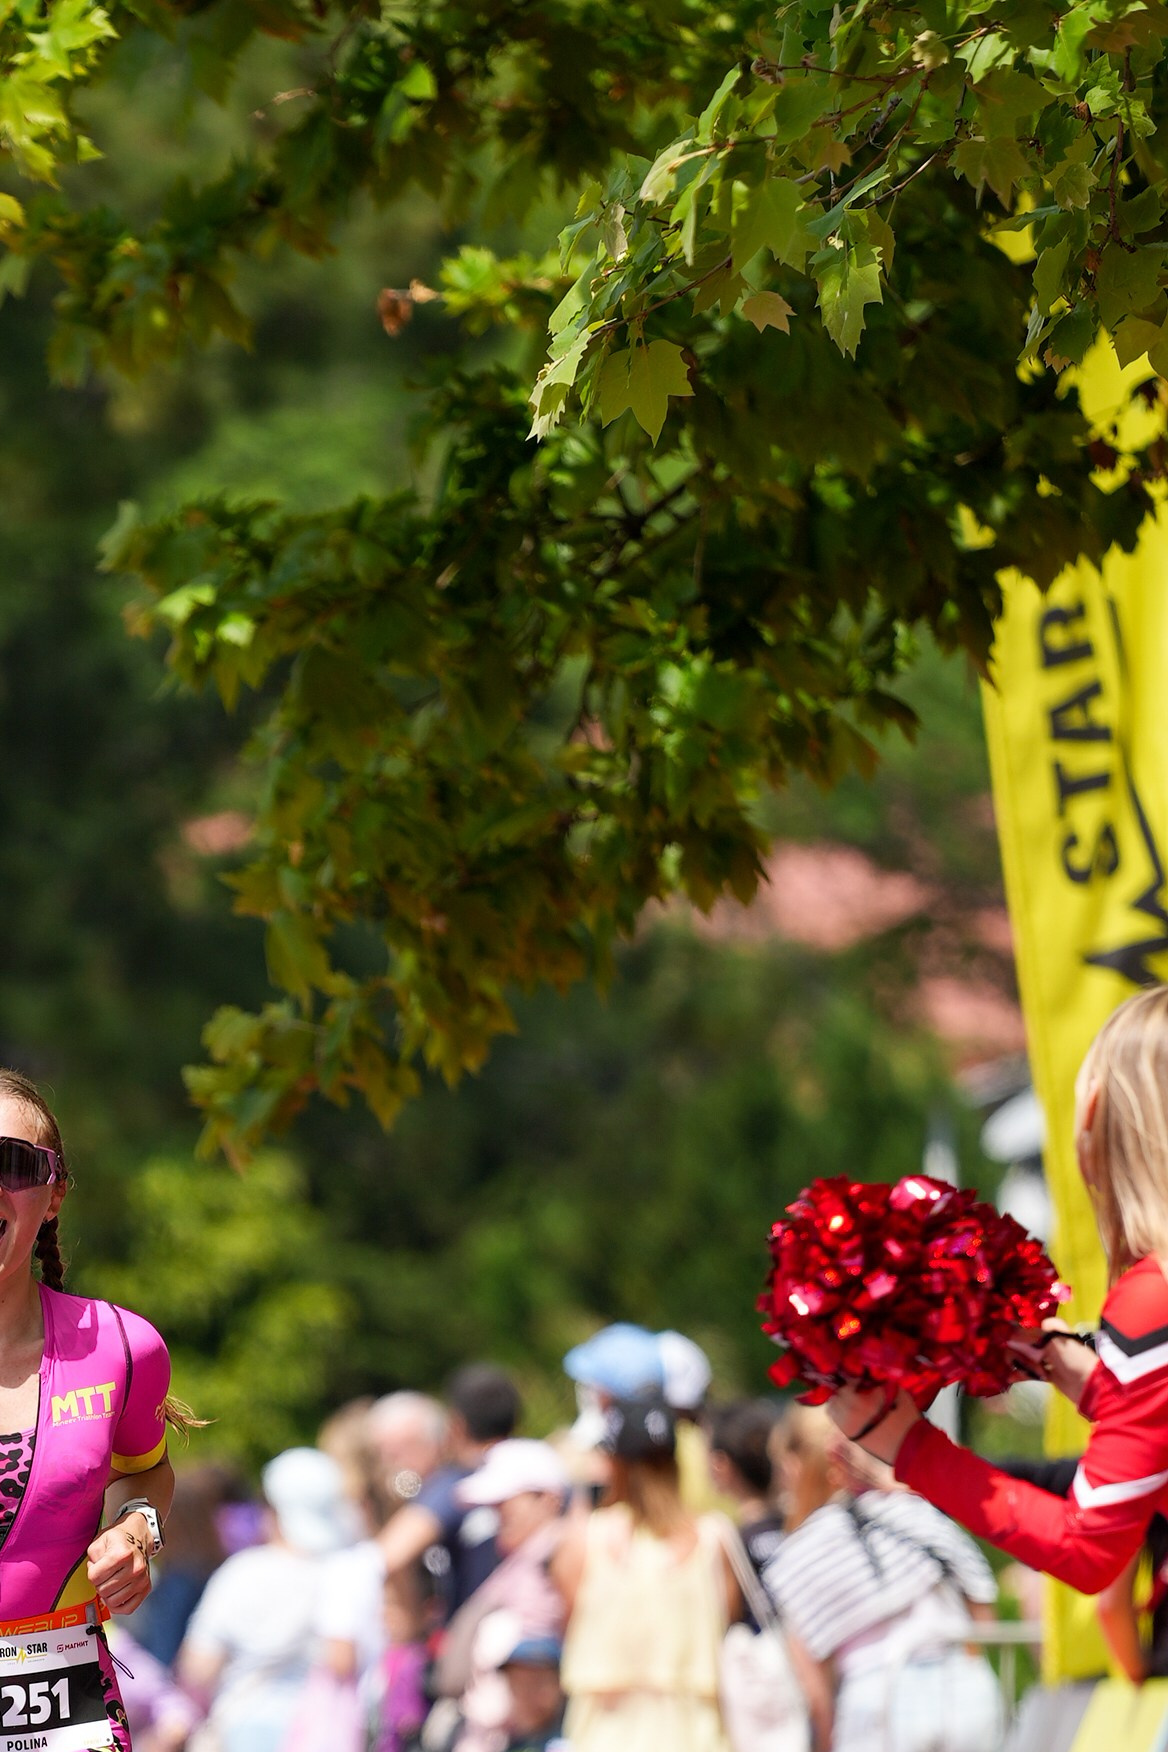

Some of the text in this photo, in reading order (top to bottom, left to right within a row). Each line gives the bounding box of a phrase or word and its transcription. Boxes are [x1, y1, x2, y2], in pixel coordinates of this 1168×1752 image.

[1038, 603, 1121, 886] STAR
[51, 1382, 116, 1422] MTT
[27, 1642, 48, 1655] STAR
[64, 1640, 89, 1652] МАГНИТ
[6, 1737, 48, 1751] POLINA
